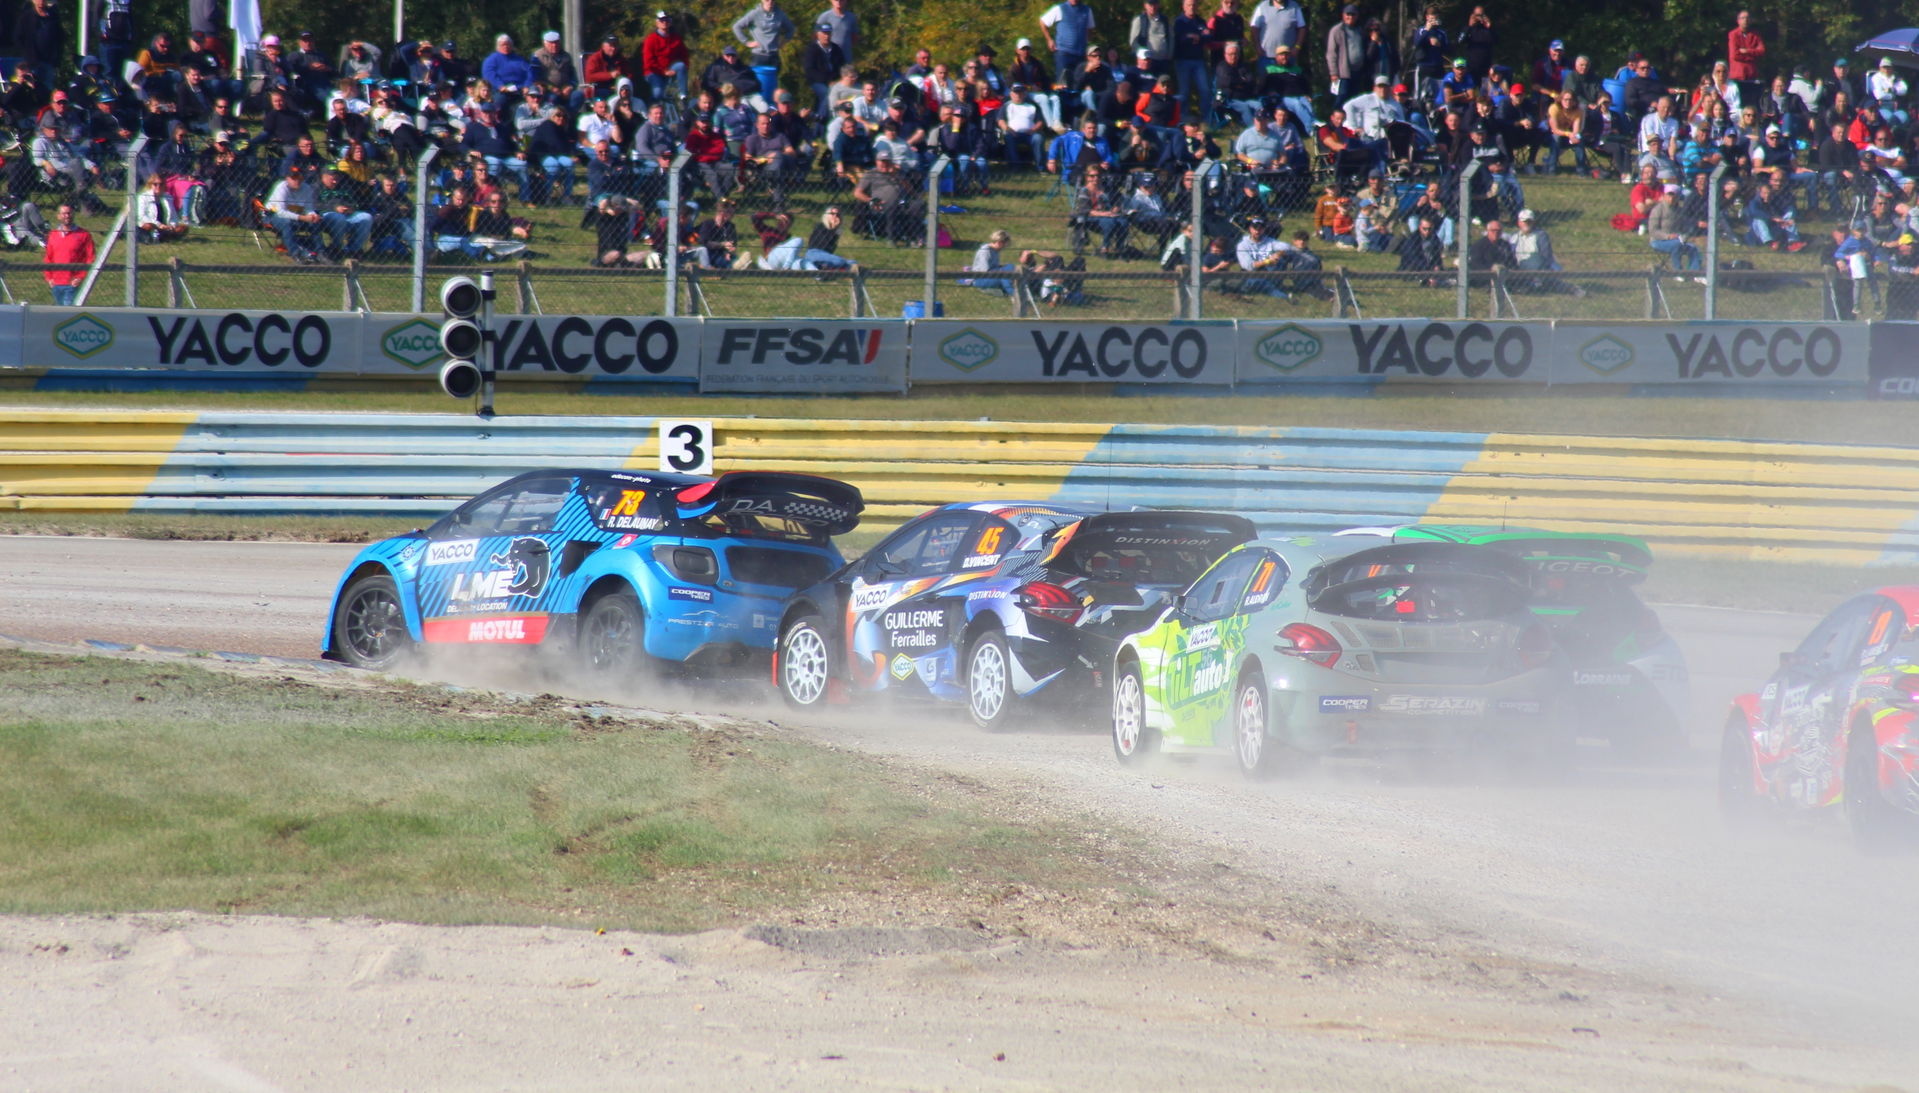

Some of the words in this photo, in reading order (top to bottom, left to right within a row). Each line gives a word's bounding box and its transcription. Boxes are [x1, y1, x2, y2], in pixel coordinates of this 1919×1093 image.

[63, 329, 106, 343] YACCO
[147, 312, 331, 367] YACCO
[716, 328, 861, 365] FFSA
[949, 343, 991, 357] YACCO
[1031, 326, 1208, 379] YACCO
[1264, 339, 1317, 357] YACCO
[1349, 322, 1533, 378] YACCO
[1666, 327, 1842, 378] YACCO
[667, 424, 705, 472] 3
[611, 489, 646, 516] 73
[606, 516, 615, 528] R.
[615, 516, 660, 530] DELAUNAY
[431, 543, 473, 561] YACCO
[976, 527, 1004, 555] 45
[451, 569, 514, 601] LME
[671, 588, 711, 597] COOPER
[855, 589, 888, 607] YACCO
[468, 619, 526, 641] MOTUL
[885, 610, 944, 630] GUILLERME
[891, 629, 937, 648] Ferrailles
[1193, 661, 1223, 697] auto
[1322, 698, 1369, 706] COOPER
